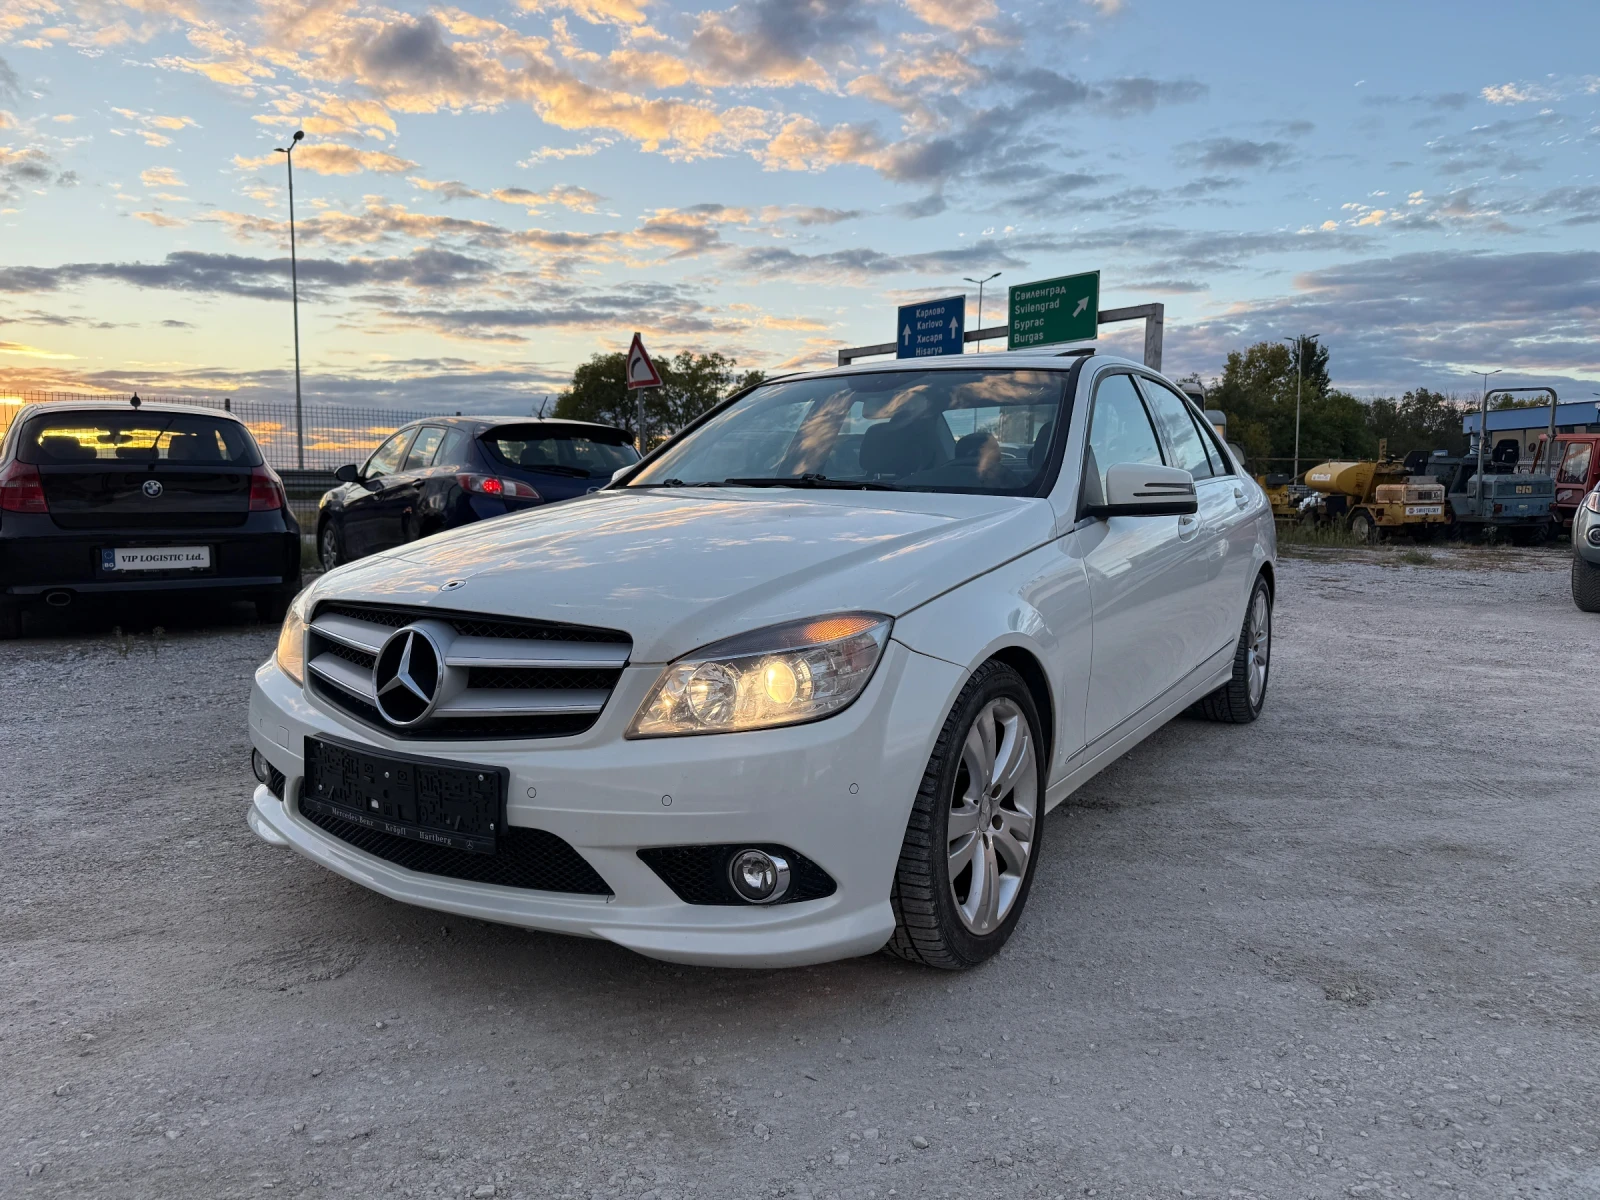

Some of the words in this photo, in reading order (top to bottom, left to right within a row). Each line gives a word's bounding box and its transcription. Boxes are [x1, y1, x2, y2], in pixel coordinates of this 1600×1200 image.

[1015, 286, 1066, 301] Свиленград
[1015, 298, 1060, 315] Svilengrad
[916, 307, 945, 319] Карлово
[917, 320, 943, 331] Karlovo
[1014, 319, 1044, 331] Бургас
[916, 333, 943, 344] Хисаря
[1014, 332, 1044, 344] Burgas
[915, 345, 943, 356] Hisarya
[121, 555, 138, 563] VIP
[140, 554, 184, 563] LOGISTIC
[186, 553, 204, 561] Ltd.
[419, 831, 452, 846] Hartberg
